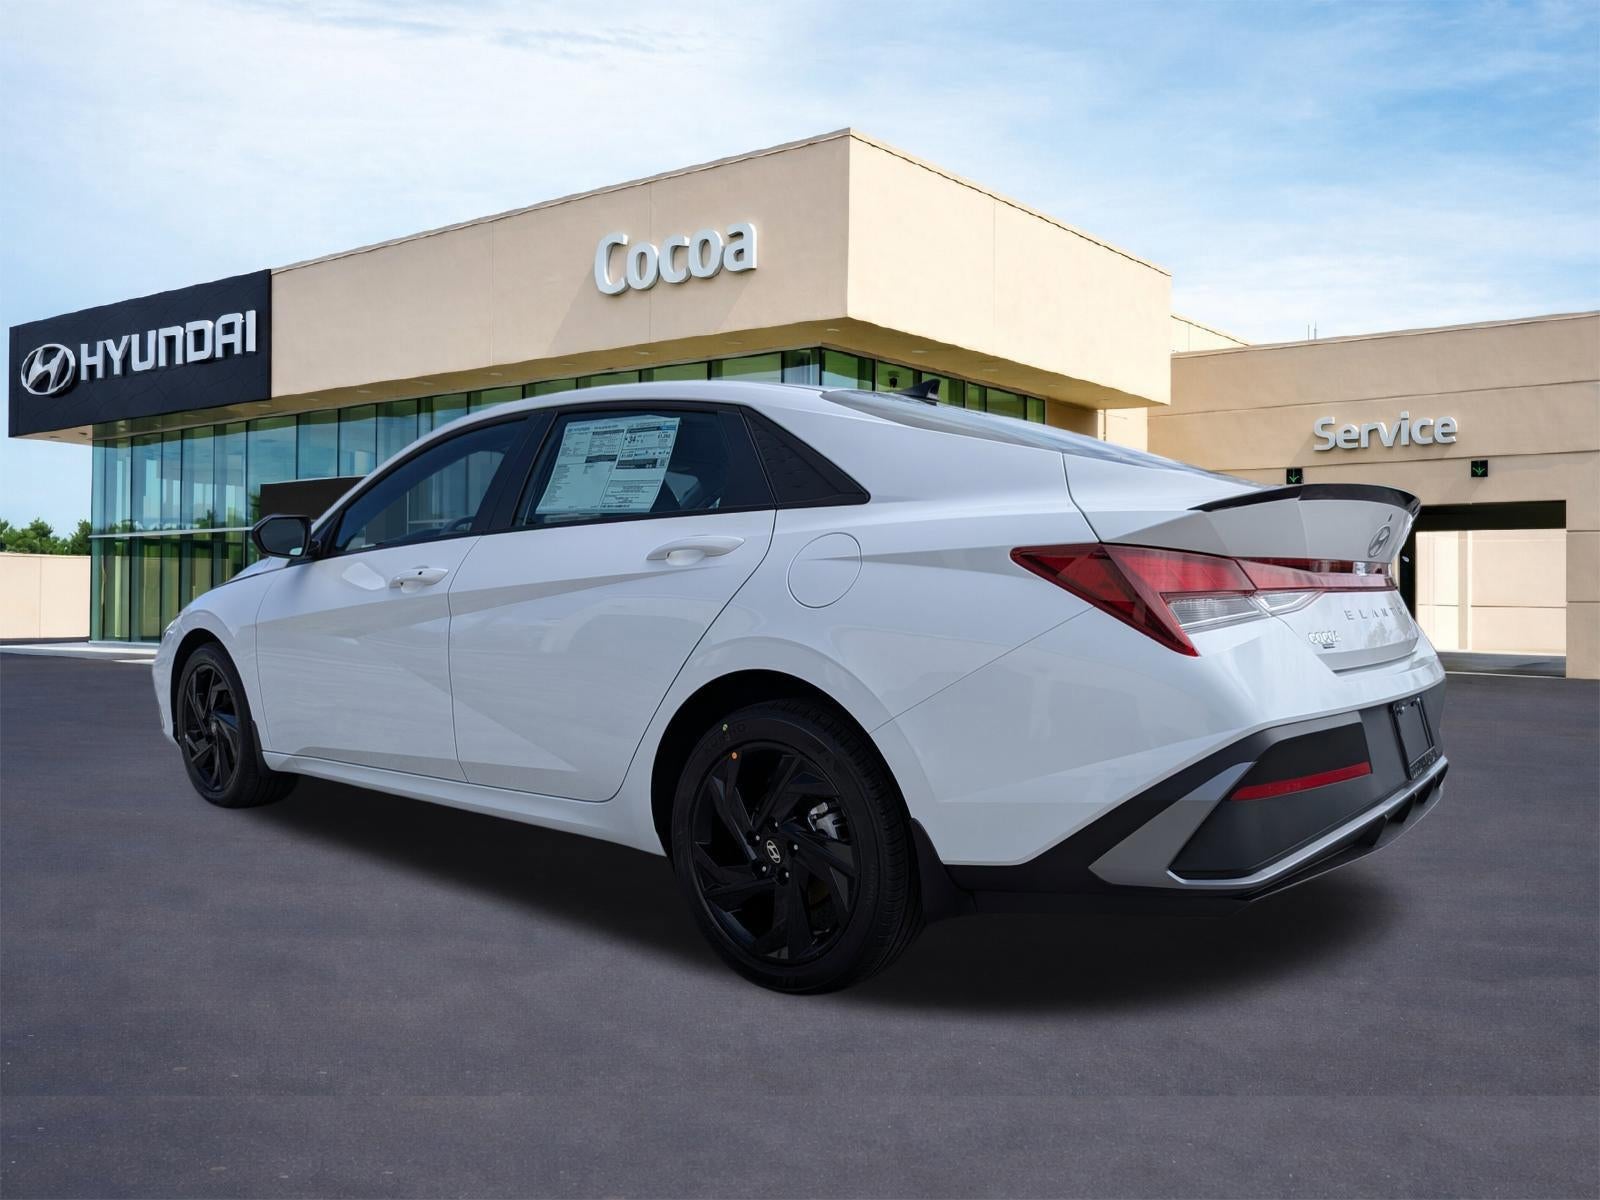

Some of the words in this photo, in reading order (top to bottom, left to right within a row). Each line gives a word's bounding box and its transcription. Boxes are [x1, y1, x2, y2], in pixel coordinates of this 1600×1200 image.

[594, 222, 758, 296] Cocoa
[80, 310, 257, 381] HYUNDAI
[1313, 410, 1458, 451] Service
